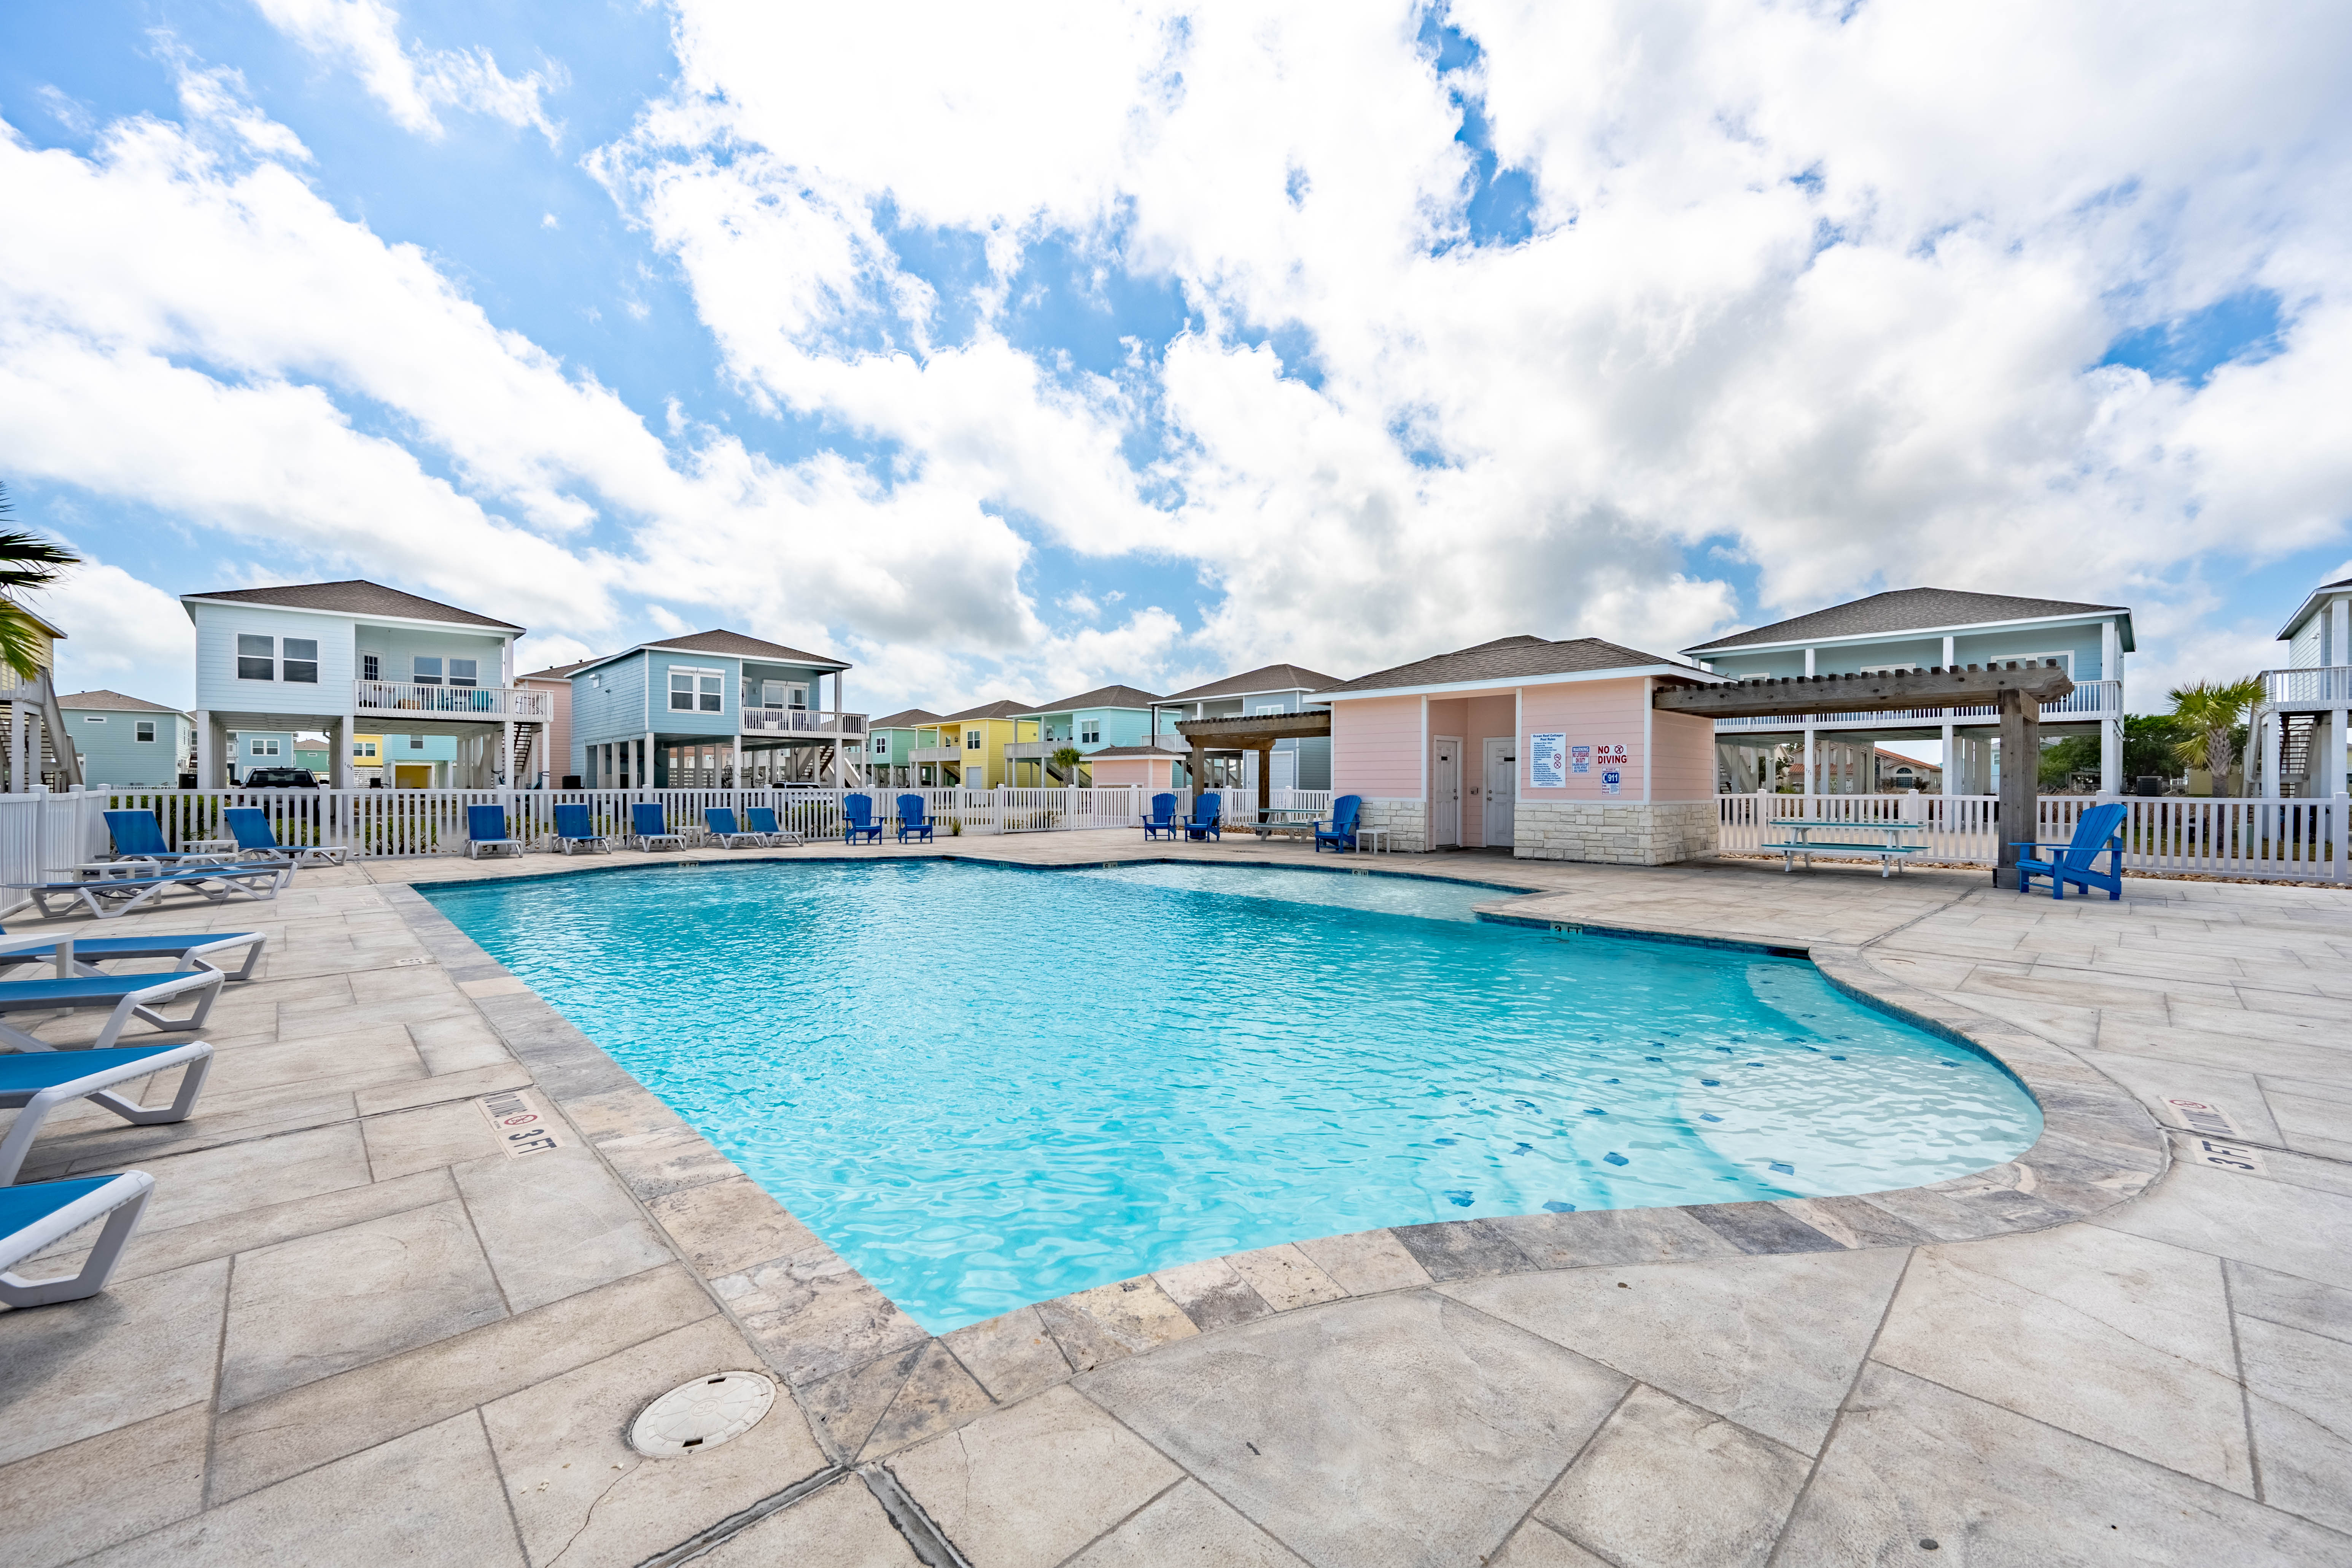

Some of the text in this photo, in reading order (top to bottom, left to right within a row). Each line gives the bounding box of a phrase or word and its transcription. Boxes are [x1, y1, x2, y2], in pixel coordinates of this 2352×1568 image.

[1598, 746, 1609, 754] NO
[1598, 755, 1627, 764] DIVING
[509, 1129, 557, 1155] 3 FT
[2201, 1140, 2255, 1170] 3 FT
